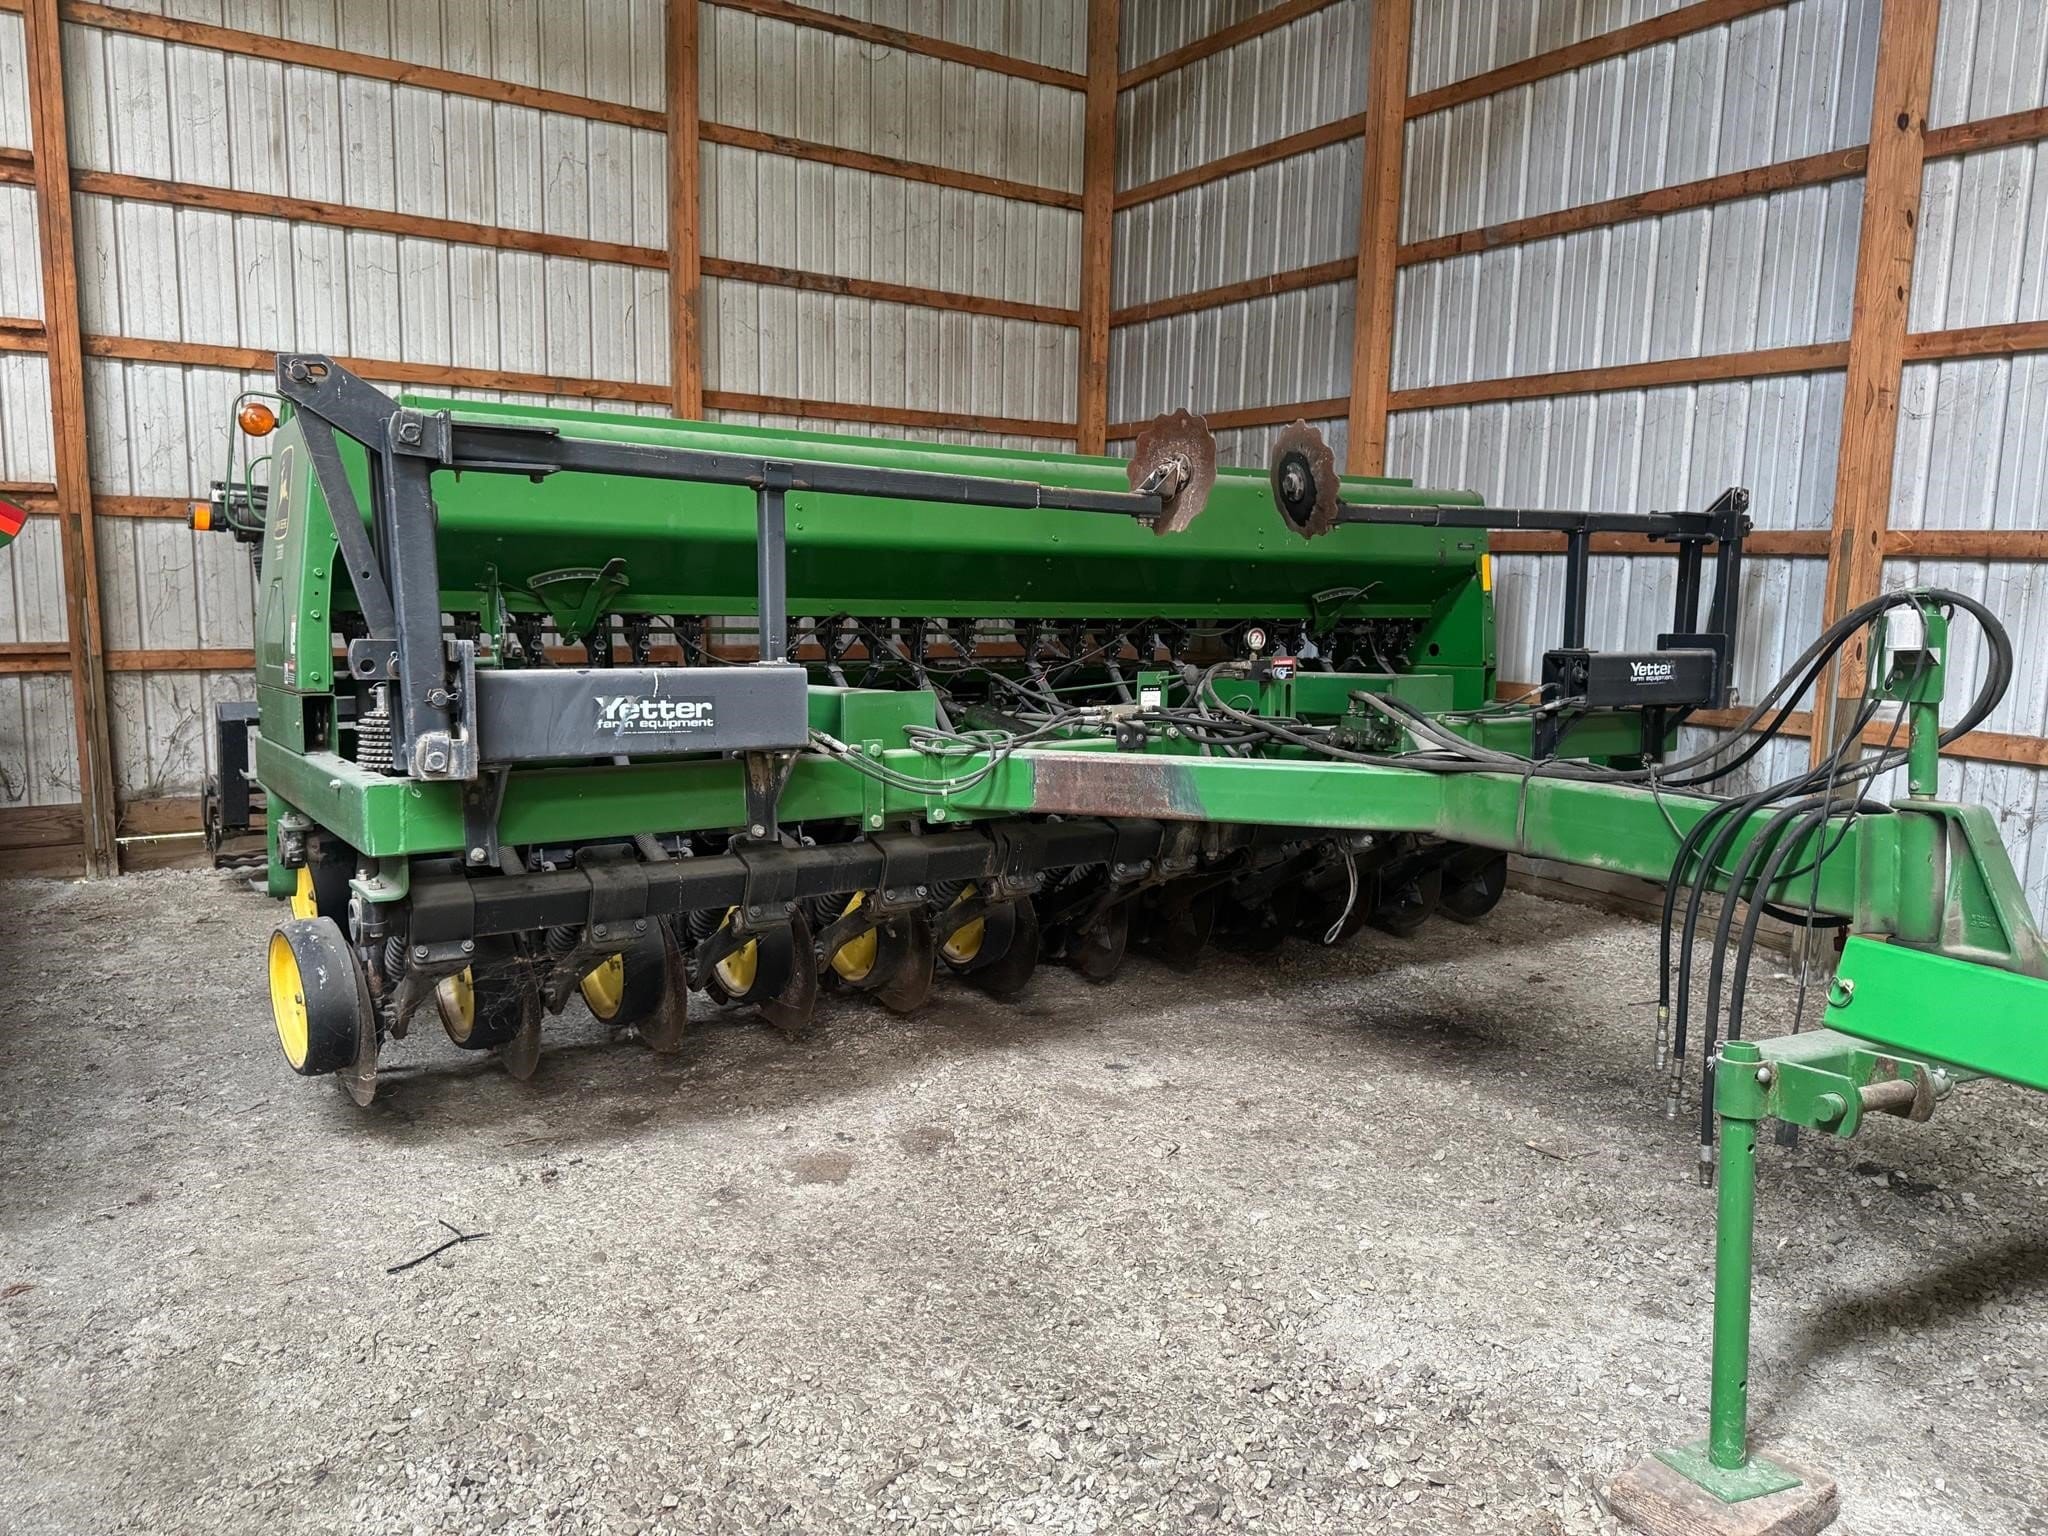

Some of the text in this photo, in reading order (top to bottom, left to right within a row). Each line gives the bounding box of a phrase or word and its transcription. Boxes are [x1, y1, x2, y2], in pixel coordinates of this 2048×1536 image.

[1630, 662, 1674, 676] Yetter
[594, 697, 713, 719] Yetter
[639, 718, 714, 730] equipment
